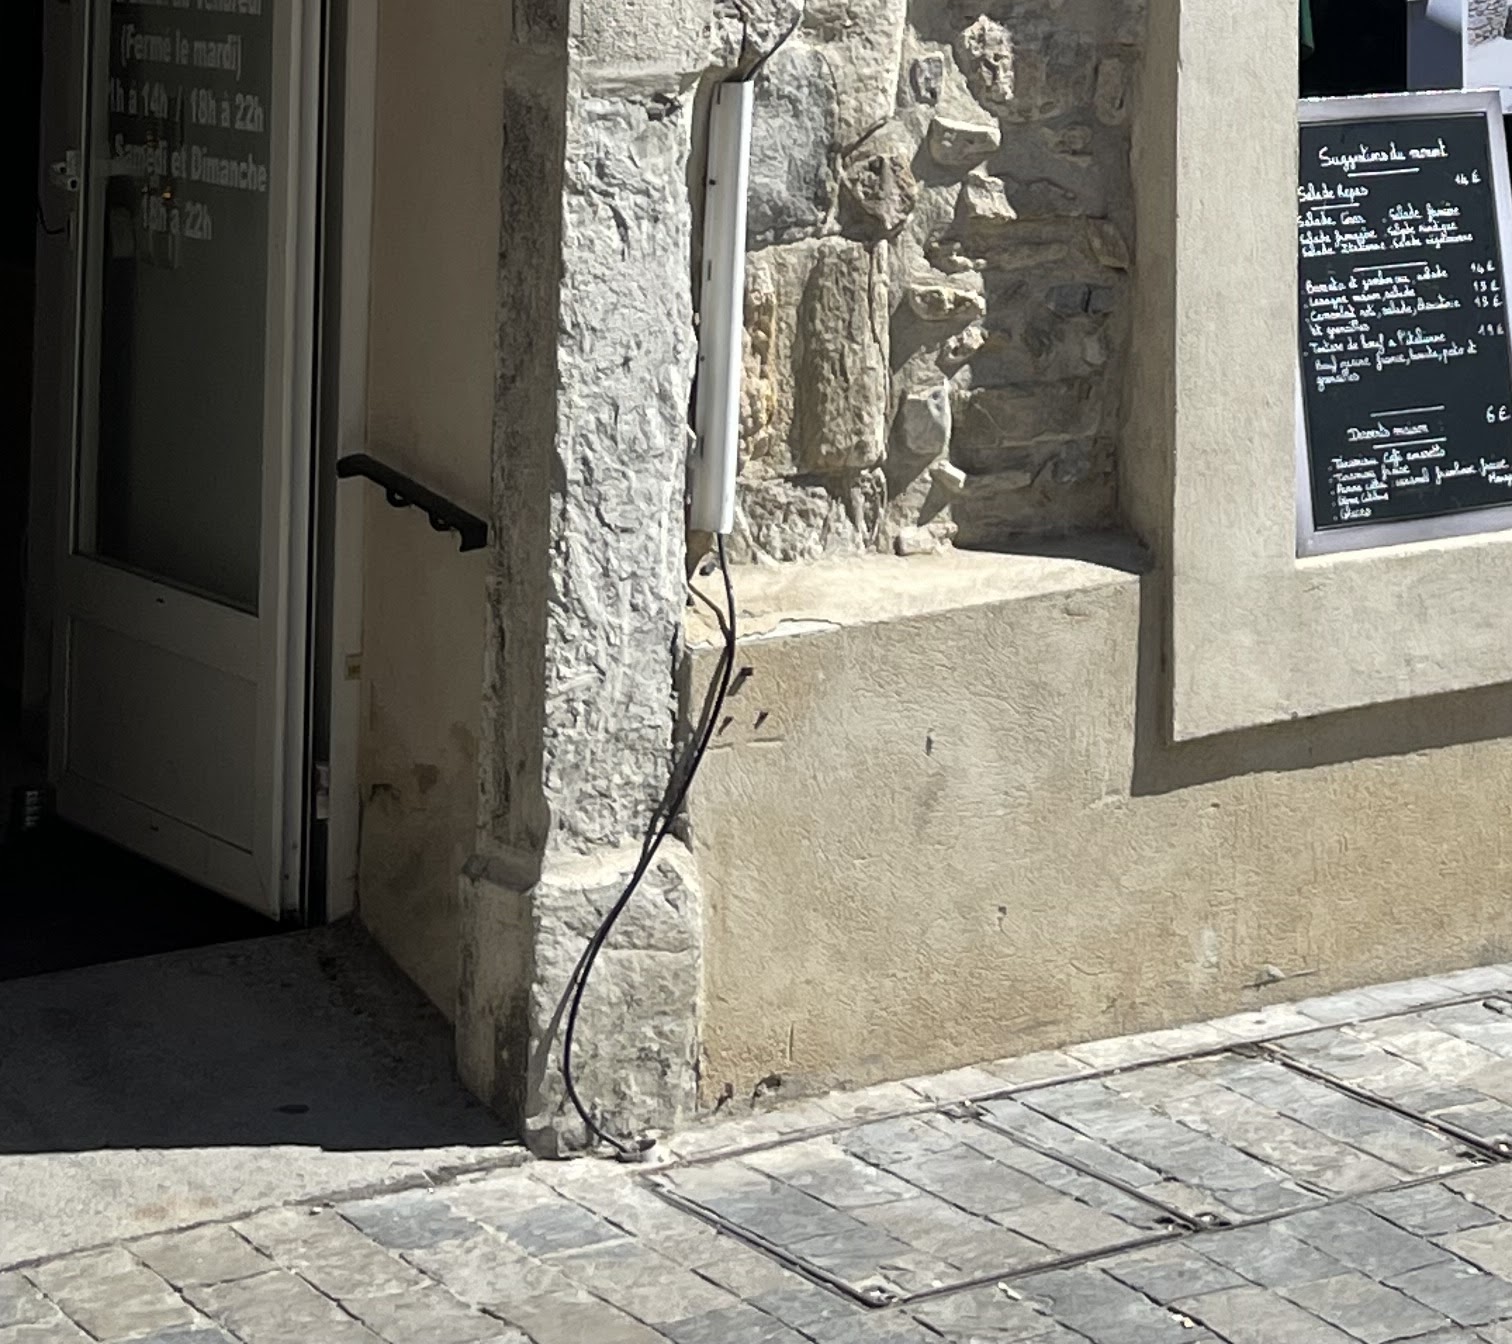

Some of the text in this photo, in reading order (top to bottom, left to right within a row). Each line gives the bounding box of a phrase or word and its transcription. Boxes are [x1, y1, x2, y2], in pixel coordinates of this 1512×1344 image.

[235, 92, 264, 133] 22h
[191, 145, 268, 193] Dimanche
[1389, 141, 1407, 161] du
